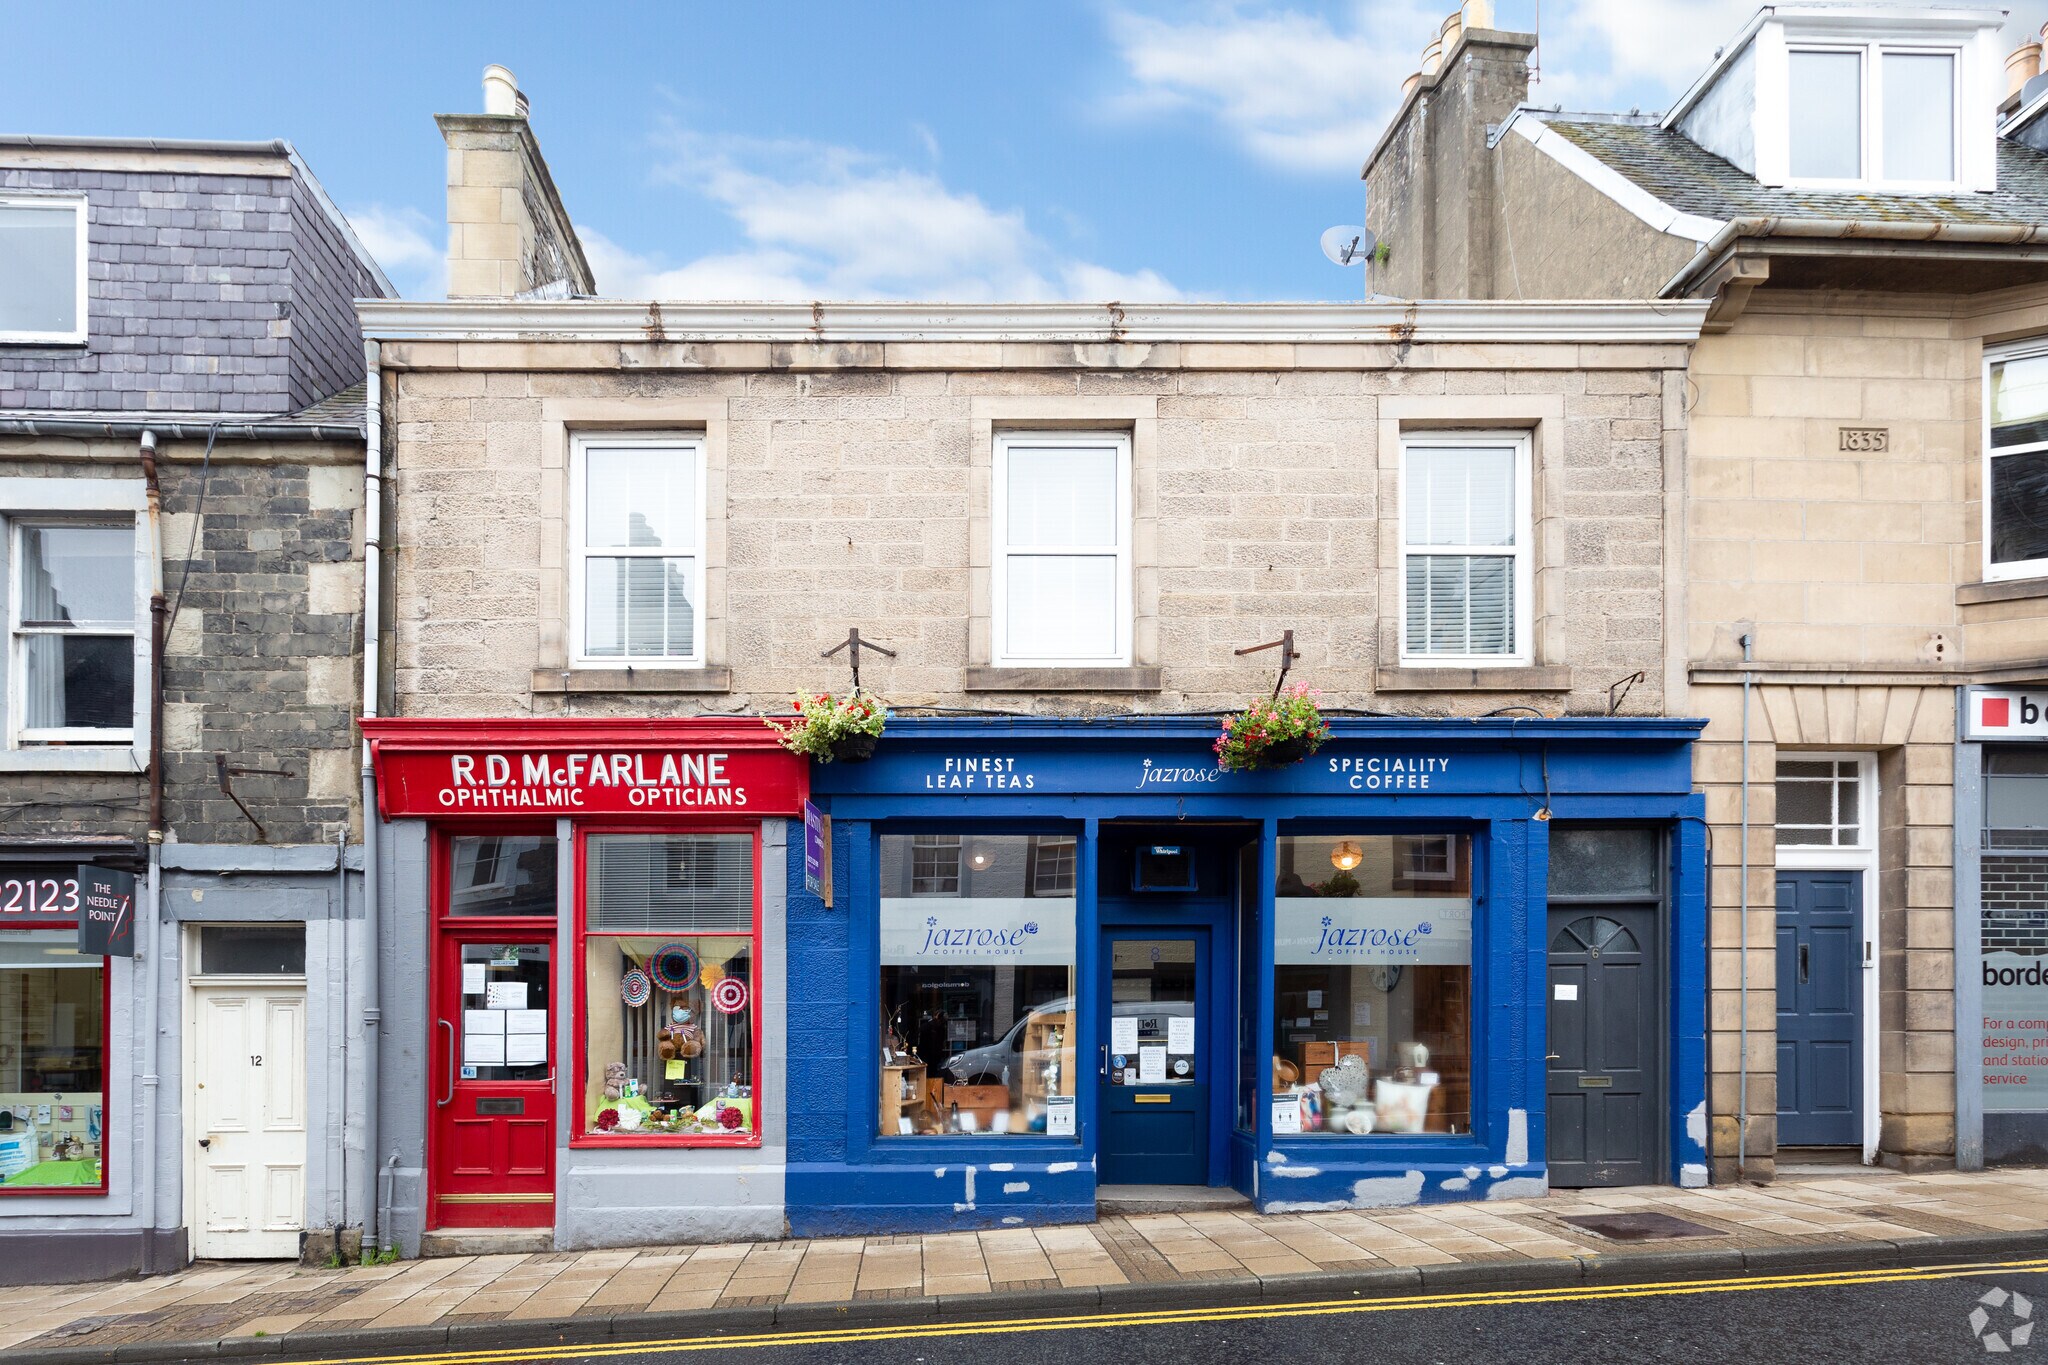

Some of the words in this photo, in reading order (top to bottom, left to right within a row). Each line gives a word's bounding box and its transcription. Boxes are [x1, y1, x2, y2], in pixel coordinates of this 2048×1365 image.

[1840, 431, 1887, 451] 1835
[2020, 696, 2048, 725] b
[945, 758, 1015, 772] FINEST
[1329, 758, 1450, 773] SPECIALITY
[926, 774, 974, 789] LEAF
[985, 774, 1035, 789] TEAS
[1135, 759, 1222, 789] jazrose
[1349, 775, 1430, 789] COFFEE
[438, 788, 585, 807] OPHTHALMIC
[628, 787, 747, 806] OPTICIANS
[0, 879, 79, 912] 2123
[93, 882, 111, 895] THE
[86, 895, 118, 909] NEEDLE
[88, 909, 117, 922] POINT
[916, 917, 1028, 955] jazrose
[1310, 916, 1423, 955] jazrose
[1151, 946, 1160, 961] 8
[1591, 946, 1600, 959] 6
[1983, 1017, 2003, 1029] For
[2006, 1020, 2015, 1029] a
[2018, 1020, 2048, 1032] com
[1983, 1035, 2029, 1051] design,
[250, 1055, 263, 1067] 12
[1983, 1053, 2008, 1066] and
[1983, 1072, 2028, 1084] service
